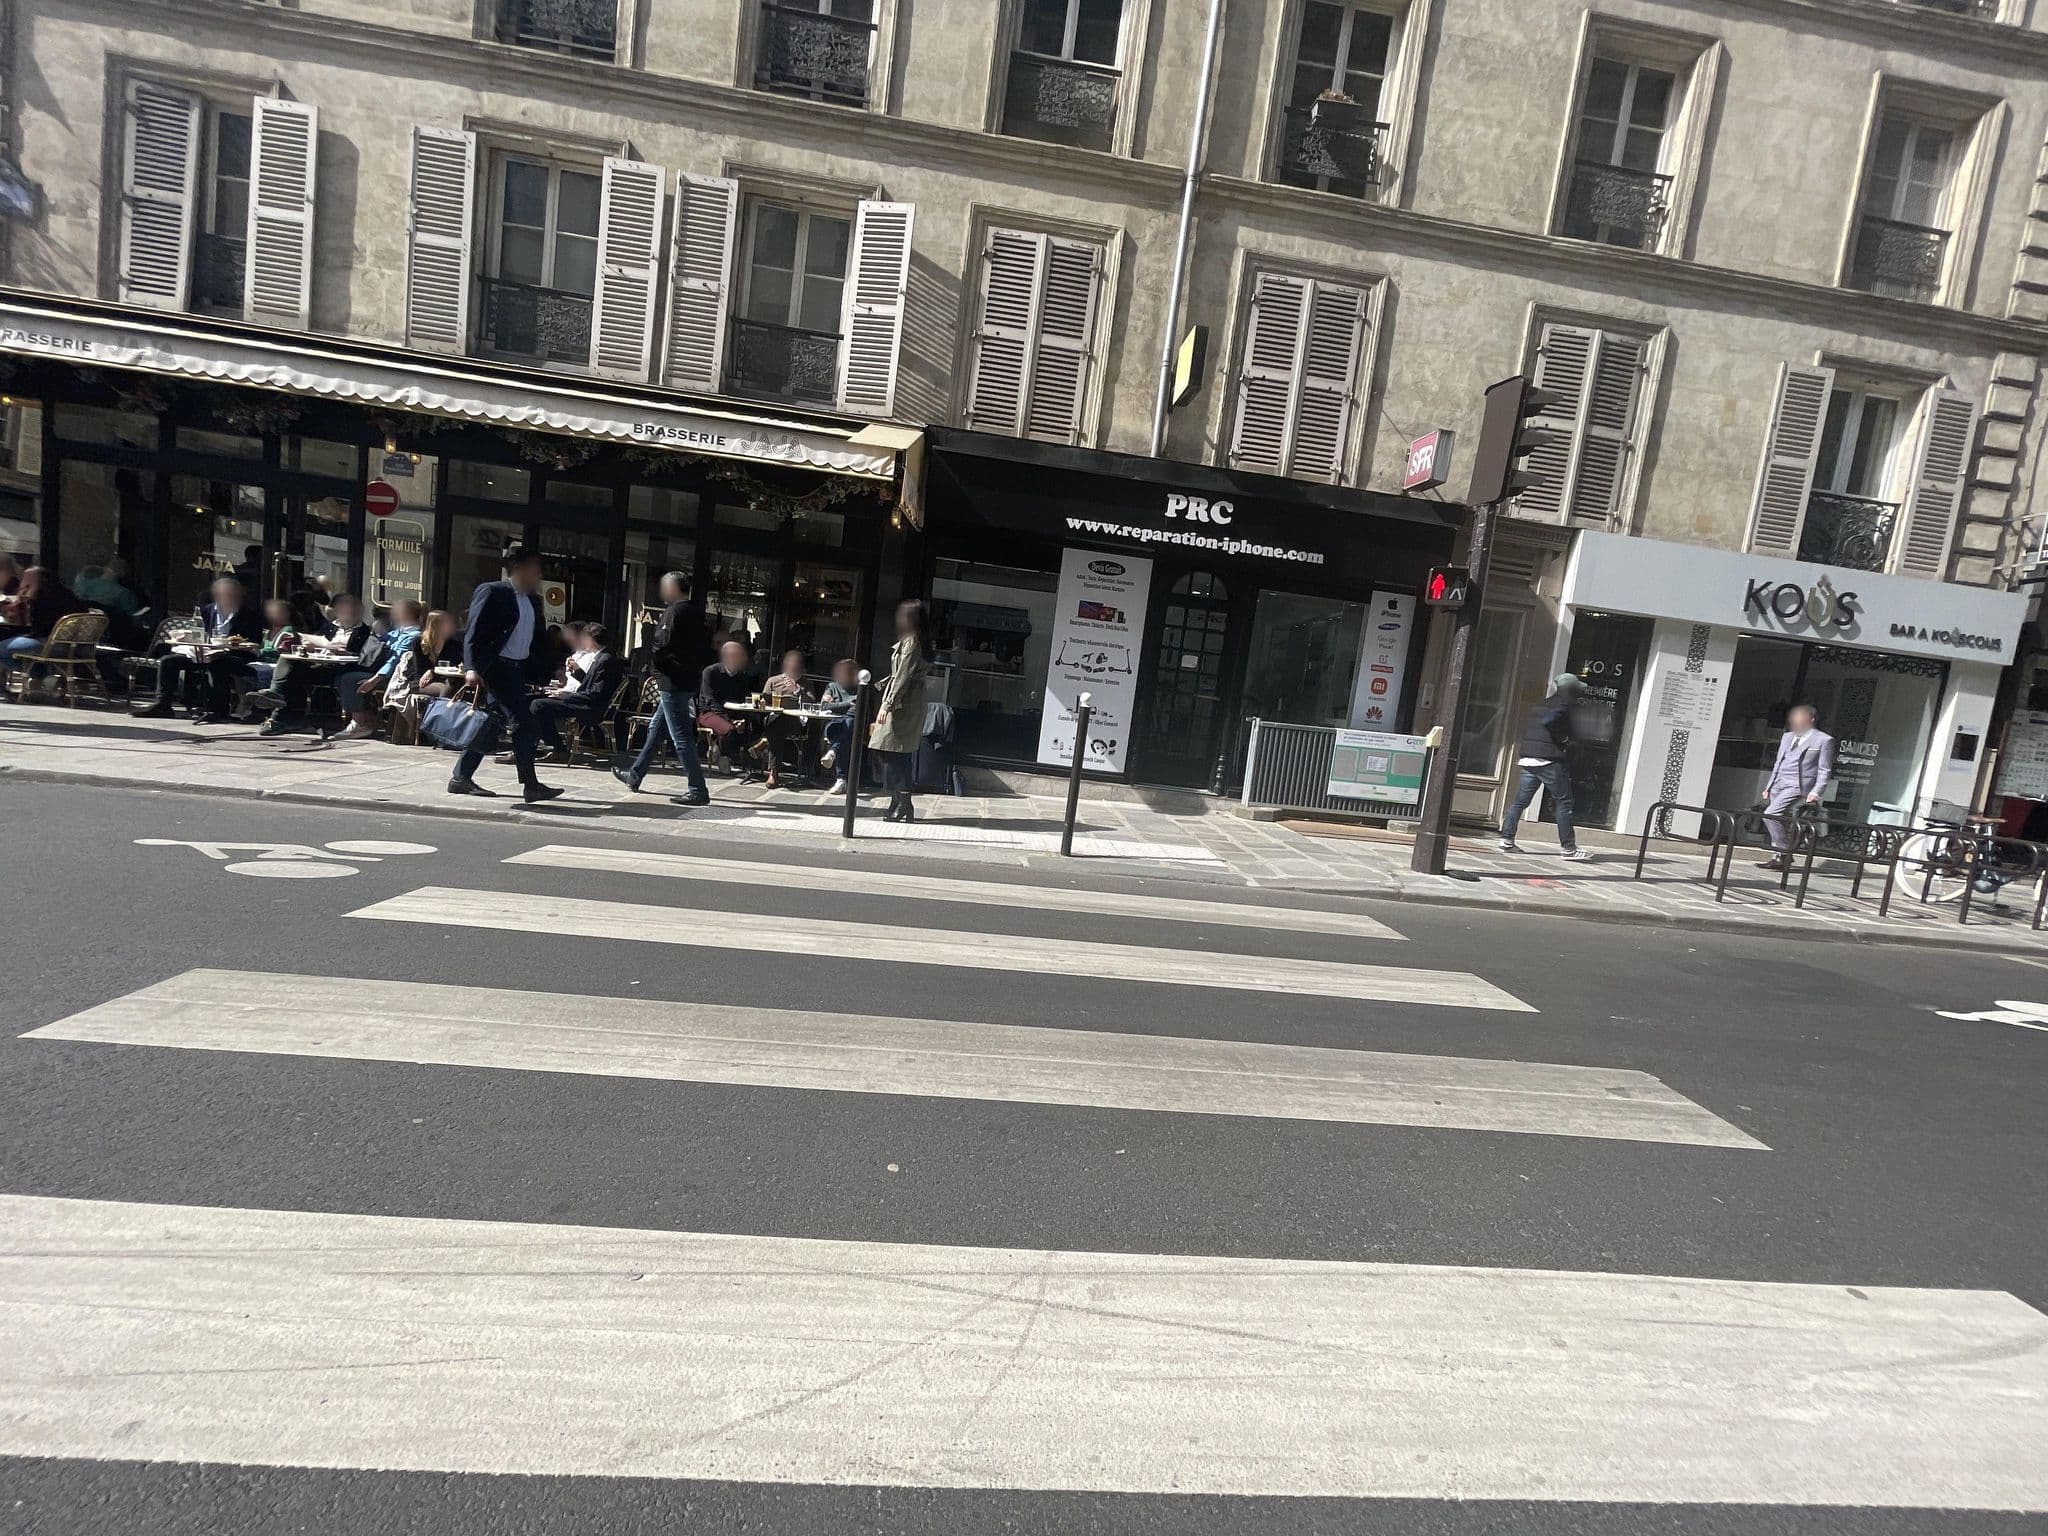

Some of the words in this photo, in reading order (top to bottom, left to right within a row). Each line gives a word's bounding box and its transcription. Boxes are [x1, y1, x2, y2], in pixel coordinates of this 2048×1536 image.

[633, 423, 727, 446] BRASSERIE
[740, 431, 803, 458] JAJA
[1410, 445, 1433, 476] SFR
[1164, 493, 1234, 525] PRC
[376, 537, 421, 554] FORMULE
[1066, 517, 1324, 564] www.reparation-iphone.com
[192, 556, 236, 574] JAJA
[387, 559, 409, 573] MIDI
[376, 578, 393, 588] PLAT
[405, 581, 423, 591] JOUR
[1890, 623, 1915, 639] BAR
